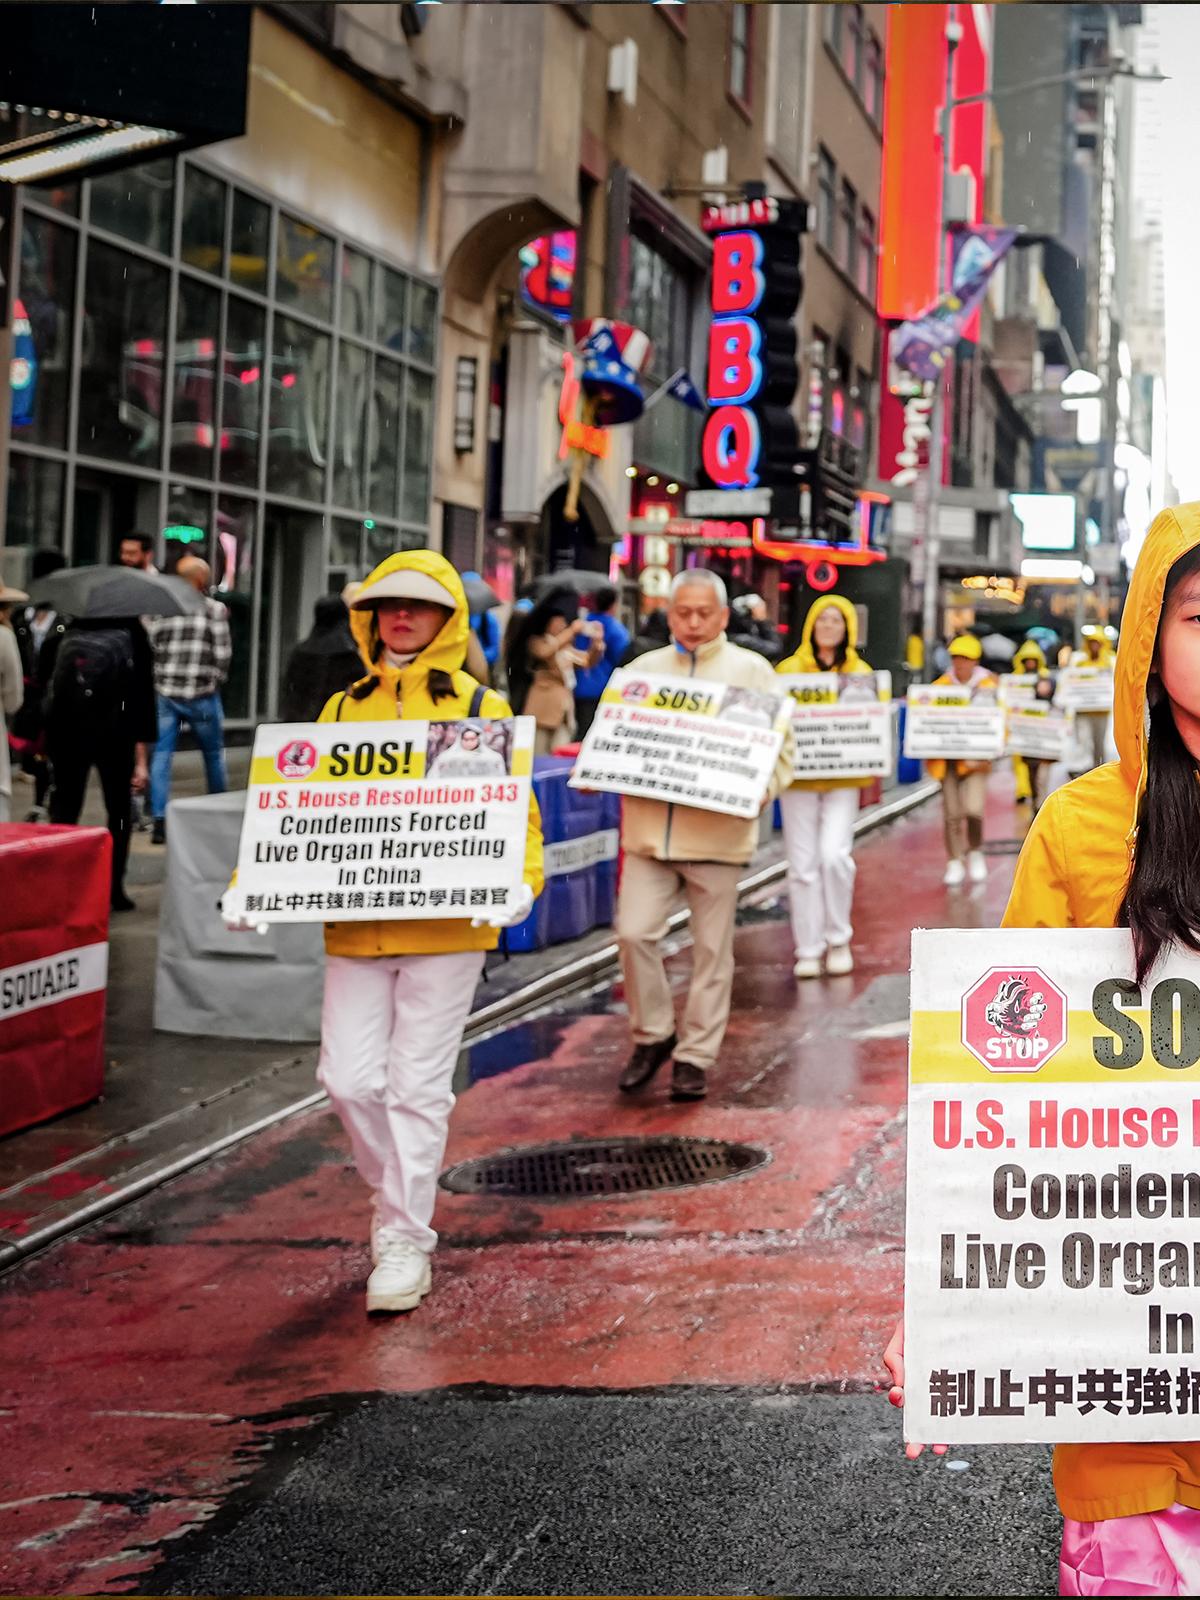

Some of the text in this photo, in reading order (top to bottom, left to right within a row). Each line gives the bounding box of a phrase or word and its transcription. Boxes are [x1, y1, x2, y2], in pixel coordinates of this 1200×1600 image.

[702, 229, 765, 490] BBQ
[654, 685, 714, 715] SOS!
[328, 741, 413, 777] SOS!
[258, 783, 518, 810] U.S. House Resolution 343
[280, 810, 486, 836] Condemns Forced
[255, 838, 505, 864] Live Organ Harvesting
[338, 867, 421, 886] In China
[986, 1037, 1050, 1060] STOP
[933, 1099, 1016, 1150] U.S.
[1029, 1100, 1179, 1149] House
[939, 1233, 1046, 1290] Live
[1148, 1304, 1194, 1354] In
